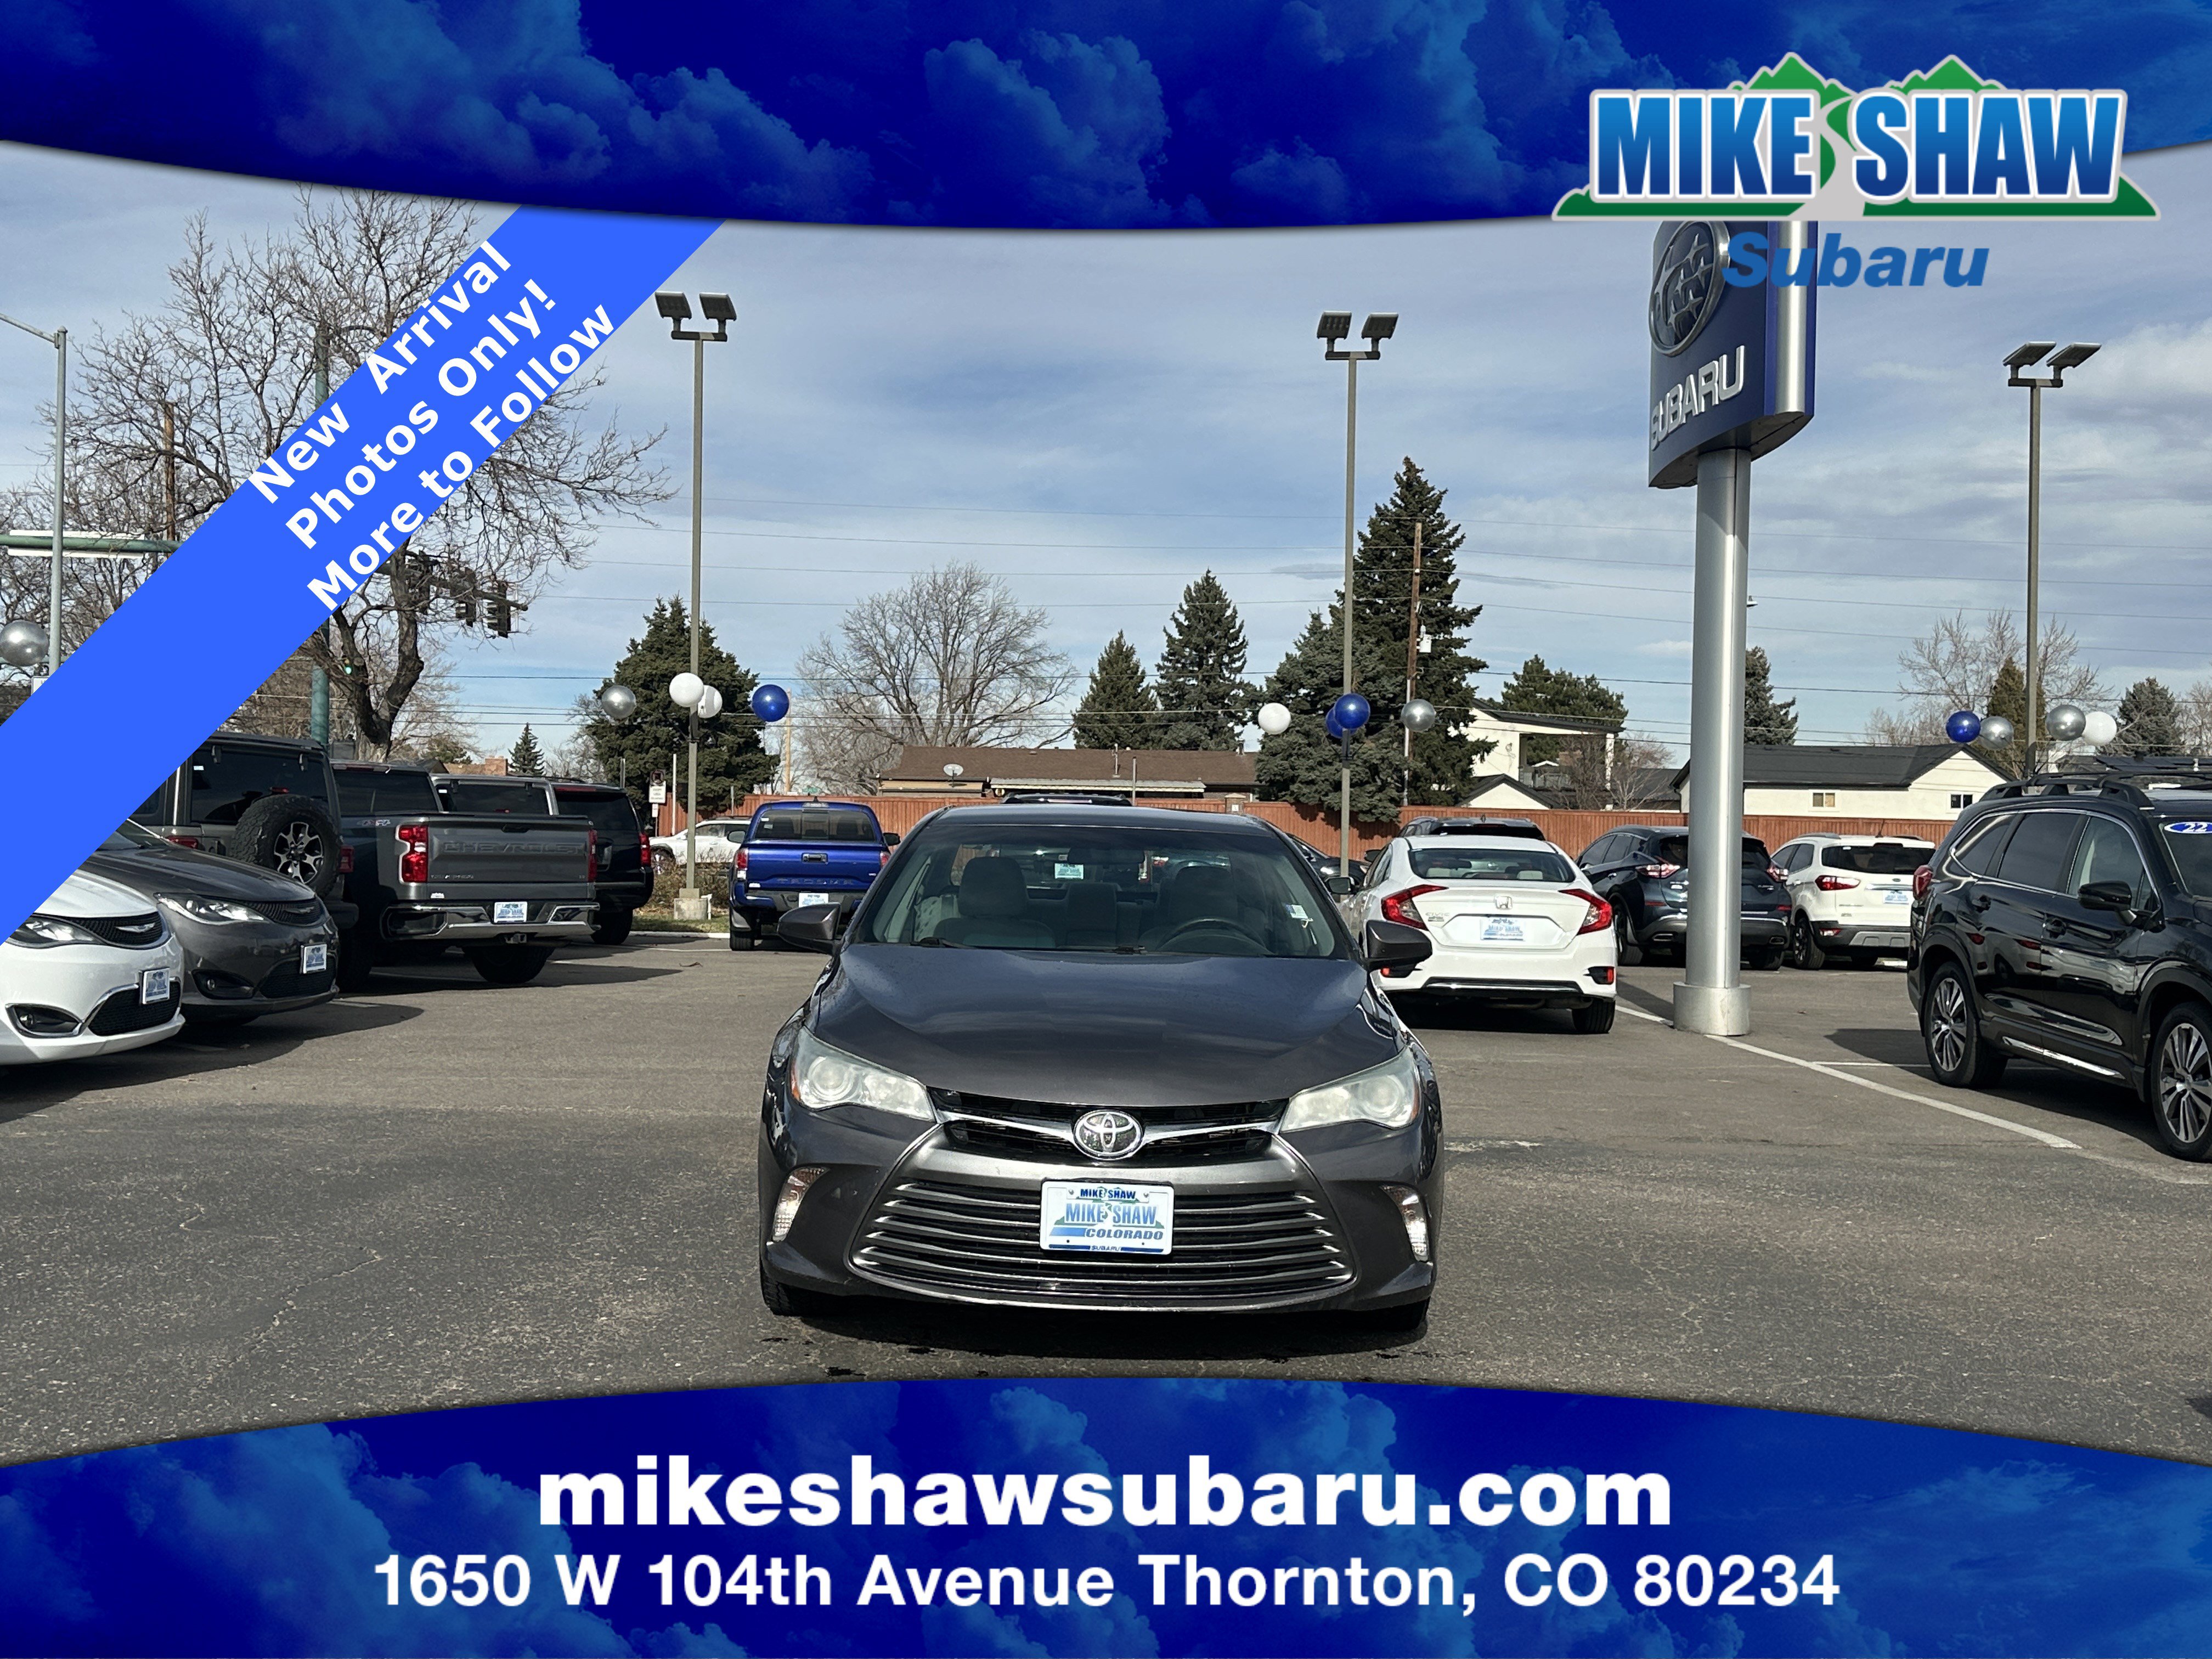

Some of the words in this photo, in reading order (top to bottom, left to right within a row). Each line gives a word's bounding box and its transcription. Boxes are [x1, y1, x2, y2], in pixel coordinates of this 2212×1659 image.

[1651, 345, 1745, 451] SUBARU
[1080, 1188, 1103, 1198] MIKE
[1108, 1189, 1137, 1199] SHAW
[1065, 1203, 1104, 1223] MIKE
[1113, 1205, 1157, 1224] SHAW
[1085, 1227, 1164, 1240] COLORADO
